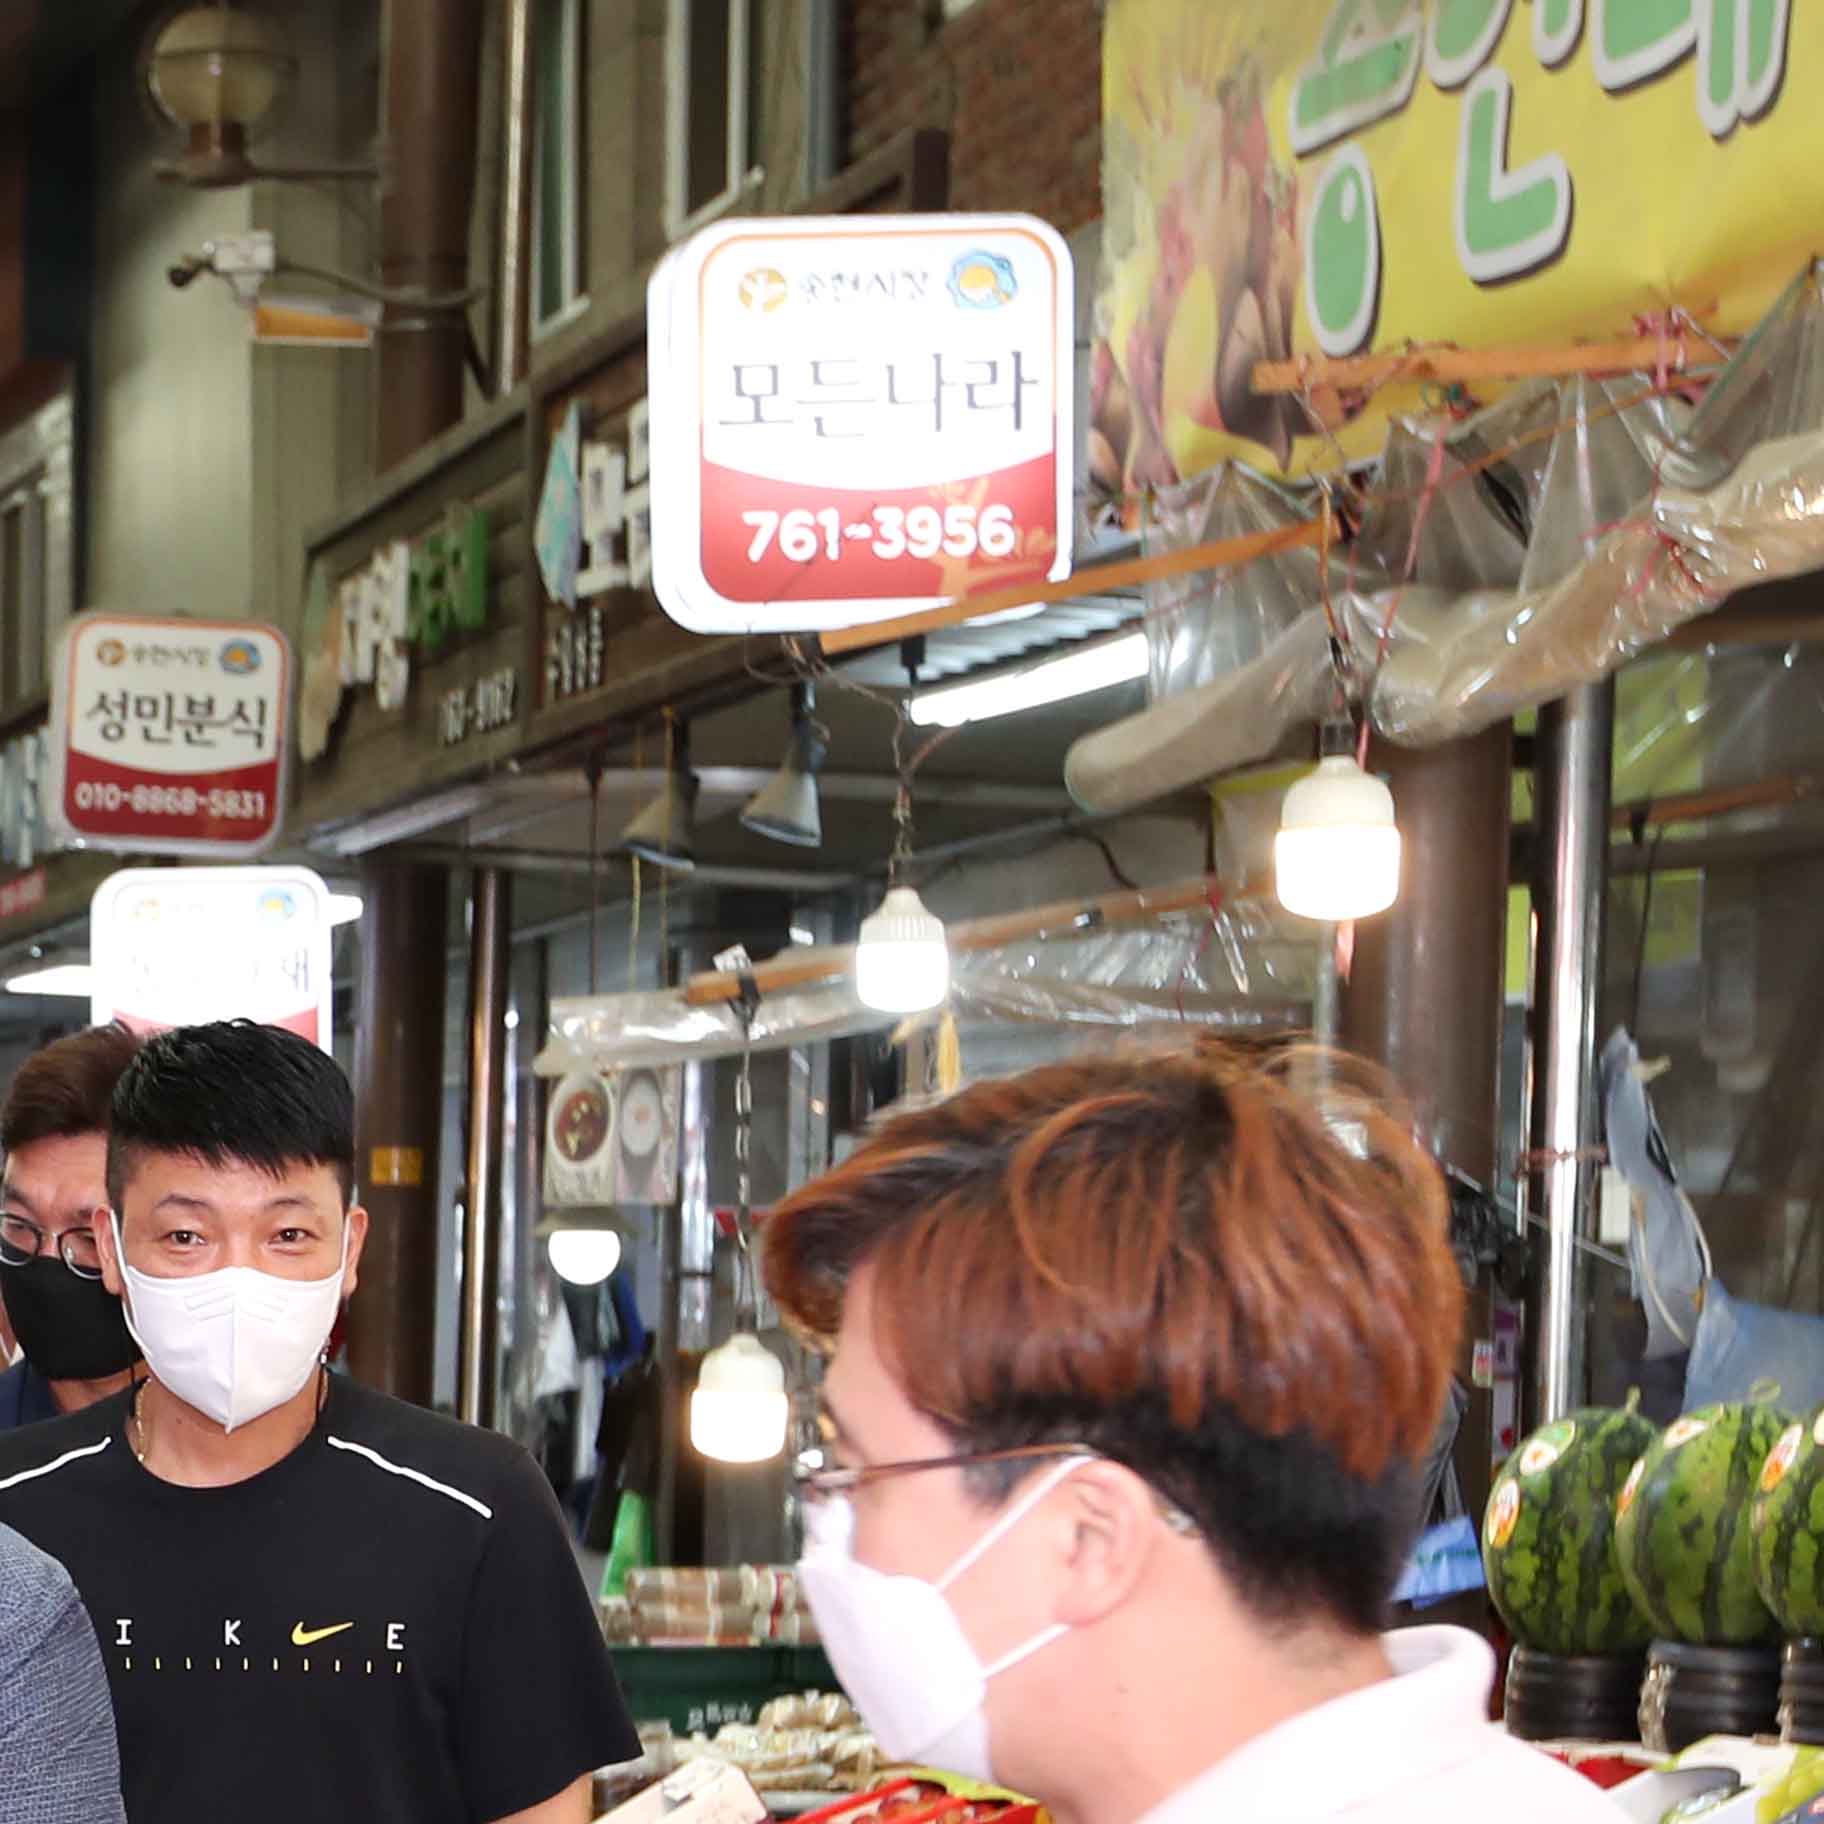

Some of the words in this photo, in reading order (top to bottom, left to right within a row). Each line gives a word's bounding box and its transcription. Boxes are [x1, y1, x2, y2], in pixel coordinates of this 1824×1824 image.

[799, 268, 929, 306] 송현시장
[720, 348, 1040, 440] 모든나라
[743, 503, 1017, 565] 761-3956
[86, 690, 270, 750] 성민분식
[74, 782, 267, 820] 010-8868-5831
[116, 1618, 405, 1651] IKE
